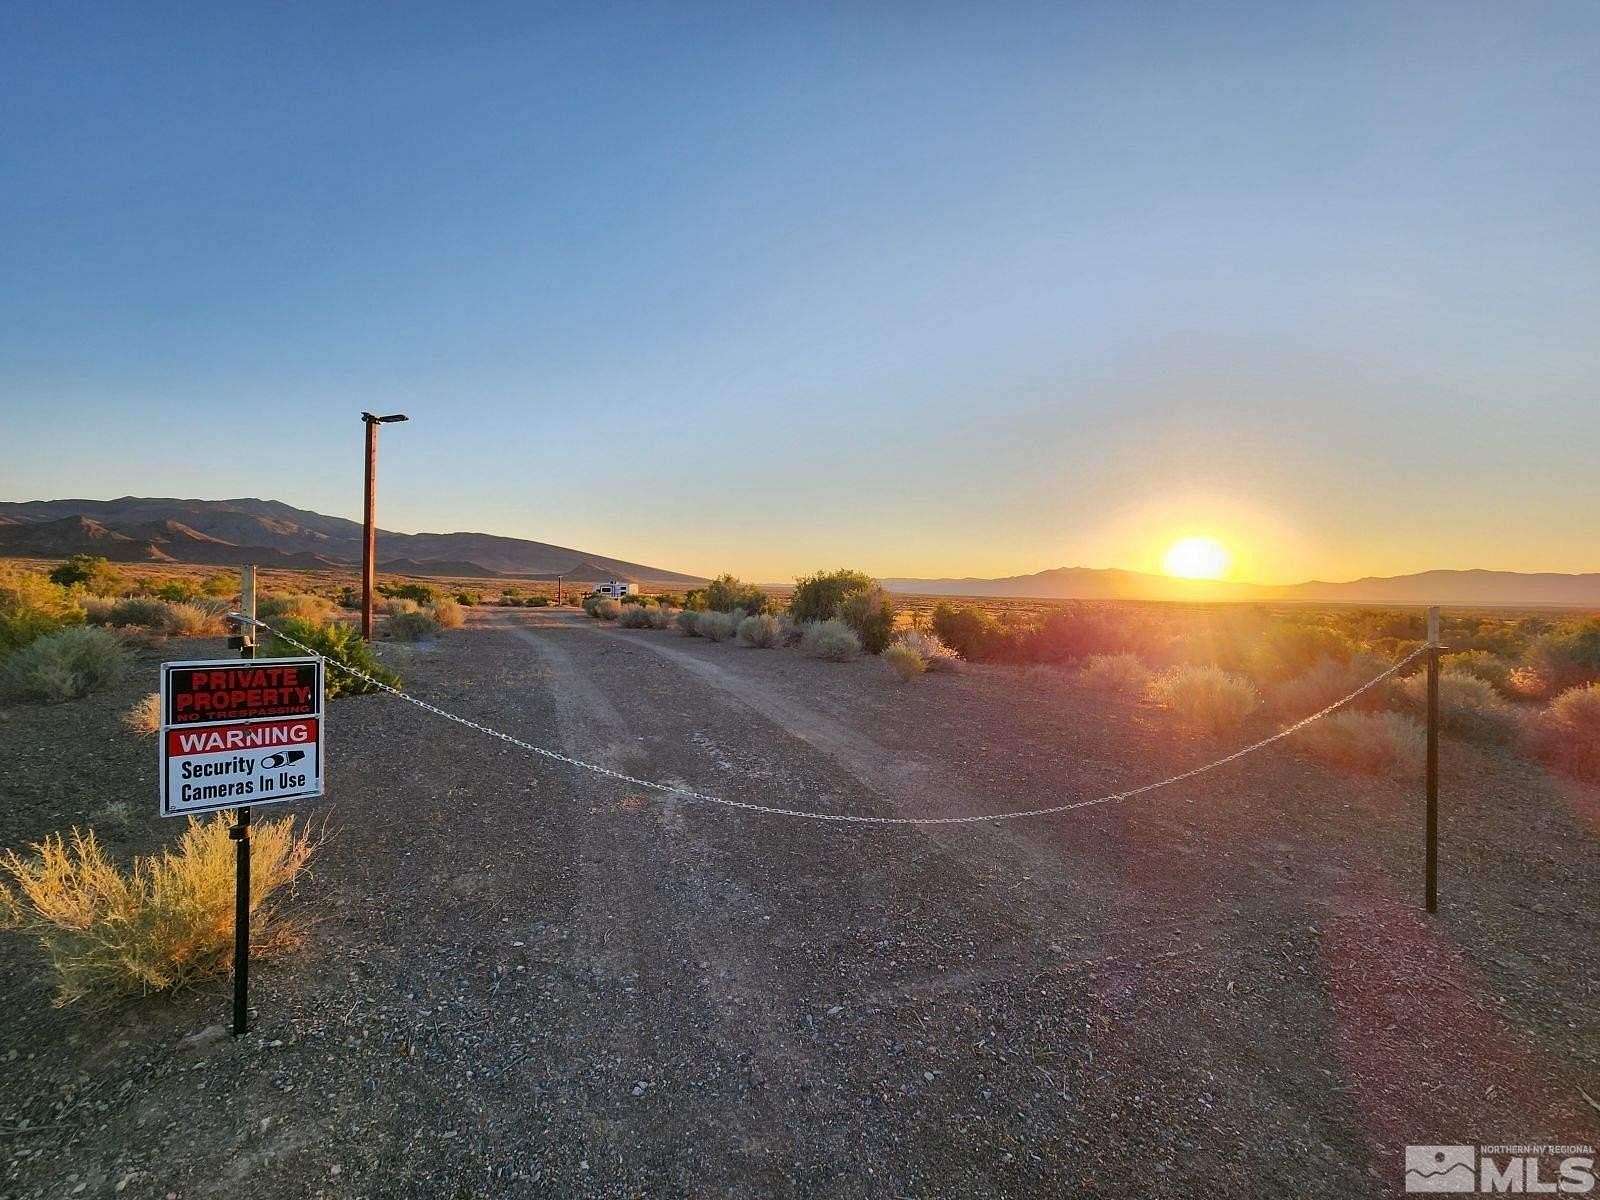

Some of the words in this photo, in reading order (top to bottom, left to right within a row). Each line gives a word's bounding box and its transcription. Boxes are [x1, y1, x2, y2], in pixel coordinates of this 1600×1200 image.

[192, 668, 298, 690] PRIVATE
[176, 687, 310, 711] PROPERTY
[177, 713, 199, 722] NO
[206, 705, 311, 719] TRESPASSING
[179, 724, 308, 753] WARNING
[181, 756, 255, 780] Security
[181, 780, 254, 802] Cameras
[259, 775, 274, 791] In
[279, 772, 306, 790] Use
